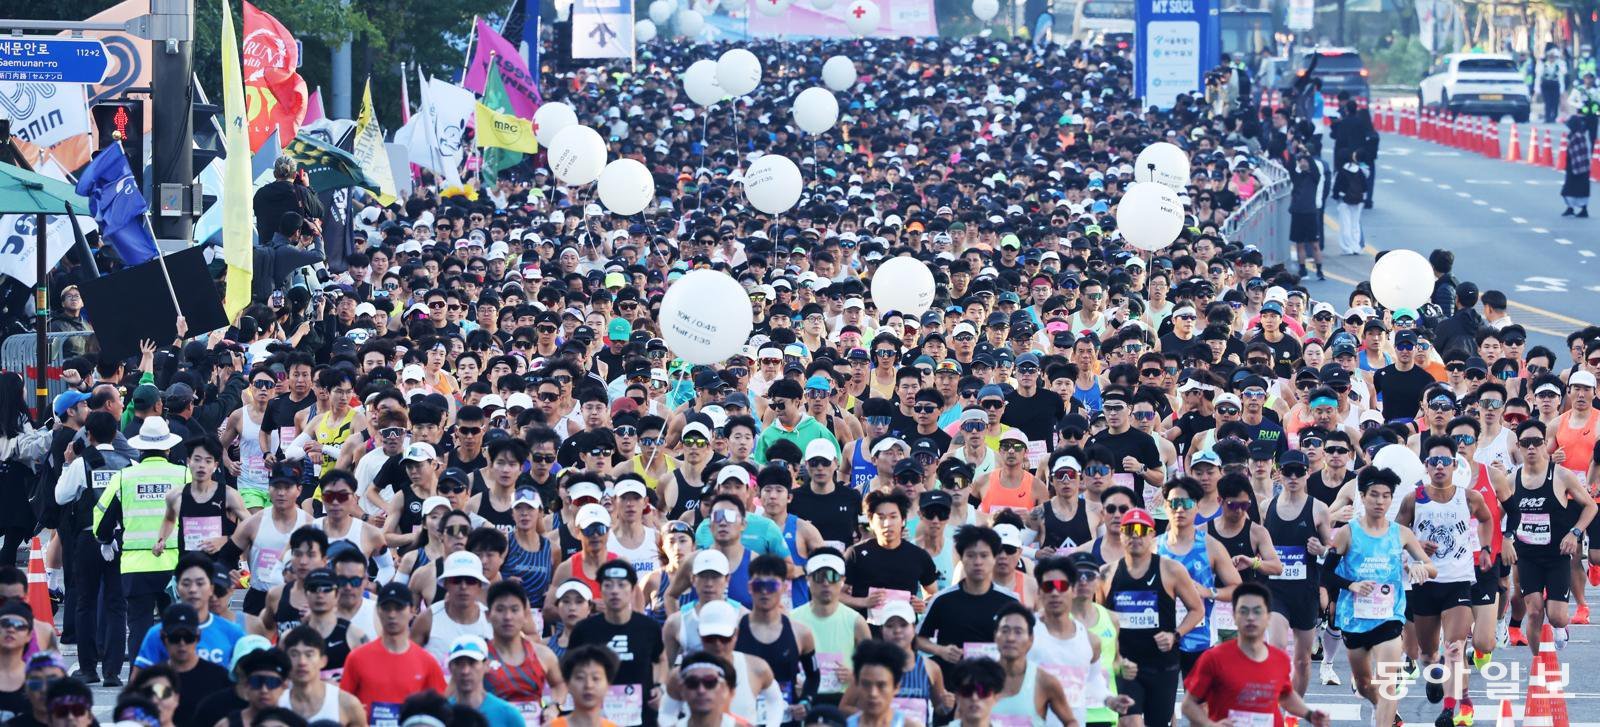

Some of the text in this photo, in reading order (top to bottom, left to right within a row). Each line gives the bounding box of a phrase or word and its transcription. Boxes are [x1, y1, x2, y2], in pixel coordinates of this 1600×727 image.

[0, 42, 50, 56] 새문안로
[494, 120, 518, 133] MRC
[1258, 429, 1281, 440] RUN
